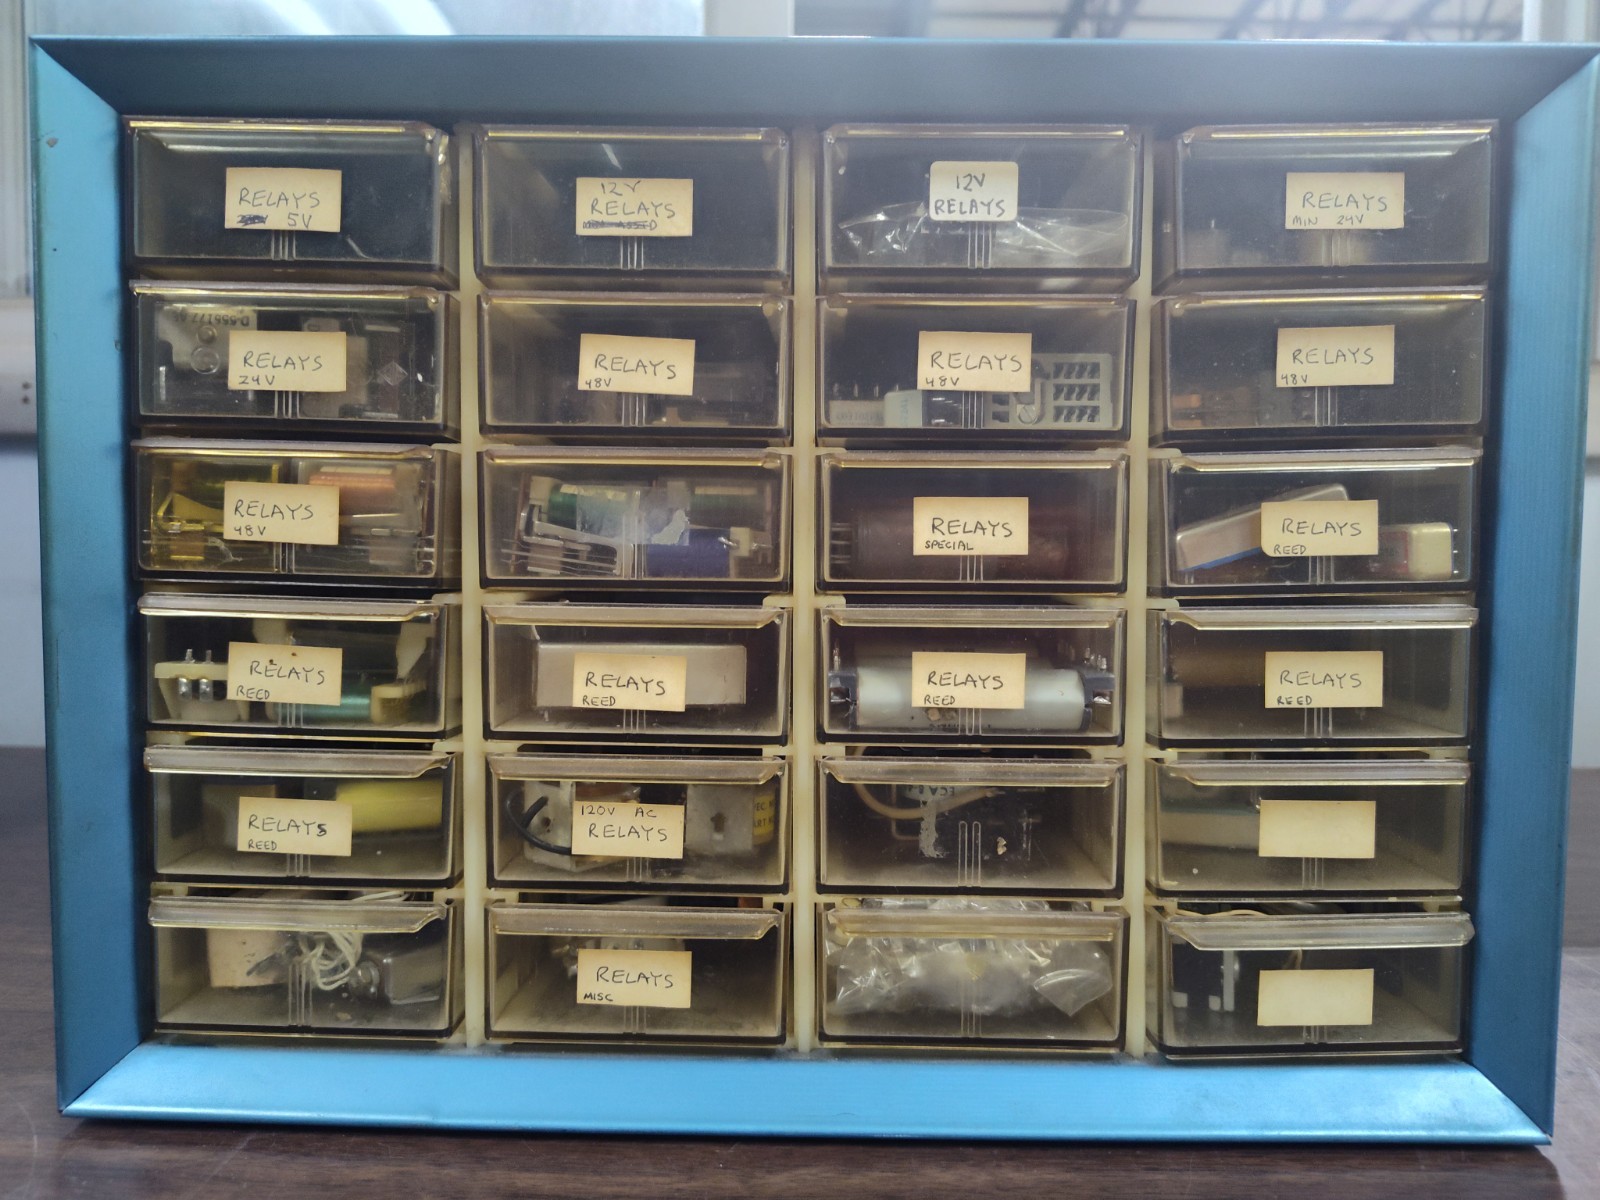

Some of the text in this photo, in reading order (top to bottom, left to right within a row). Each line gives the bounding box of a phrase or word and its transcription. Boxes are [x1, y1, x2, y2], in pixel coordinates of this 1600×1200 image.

[600, 180, 641, 197] 12V
[956, 172, 986, 193] 12V
[238, 186, 321, 210] RELAYS
[1301, 191, 1388, 213] RELAYS
[590, 197, 676, 220] RELAYS
[934, 198, 1006, 218] RELAYS
[287, 211, 313, 228] 5V
[1292, 213, 1364, 225] MIN 24V
[243, 350, 323, 372] RELAYS
[930, 350, 1023, 373] RELAYS
[1292, 347, 1374, 366] RELAYS
[594, 353, 677, 380] RELAYS
[238, 374, 276, 386] 24V
[585, 377, 612, 388] 48V
[925, 375, 960, 387] 48V
[1281, 373, 1308, 384] 48V
[233, 498, 314, 521] RELAYS
[233, 524, 267, 537] 48V
[931, 516, 1013, 539] RELAYS
[1281, 517, 1362, 537] RELAYS
[924, 539, 975, 551] SPECIAL
[1273, 543, 1307, 555] REED
[249, 659, 325, 686] RELAYS
[927, 670, 1004, 691] RELAYS
[1279, 669, 1362, 690] RELAYS
[236, 685, 271, 700] REED
[584, 671, 666, 697] RELAYS
[582, 694, 617, 707] REED
[923, 693, 956, 706] REED
[1276, 694, 1313, 706] REED
[581, 804, 658, 819] 120V AC
[248, 813, 328, 838] RELAYS
[588, 822, 668, 843] RELAYS
[247, 838, 278, 851] REED
[596, 965, 674, 989] RELAYS
[583, 991, 614, 1003] MISC
